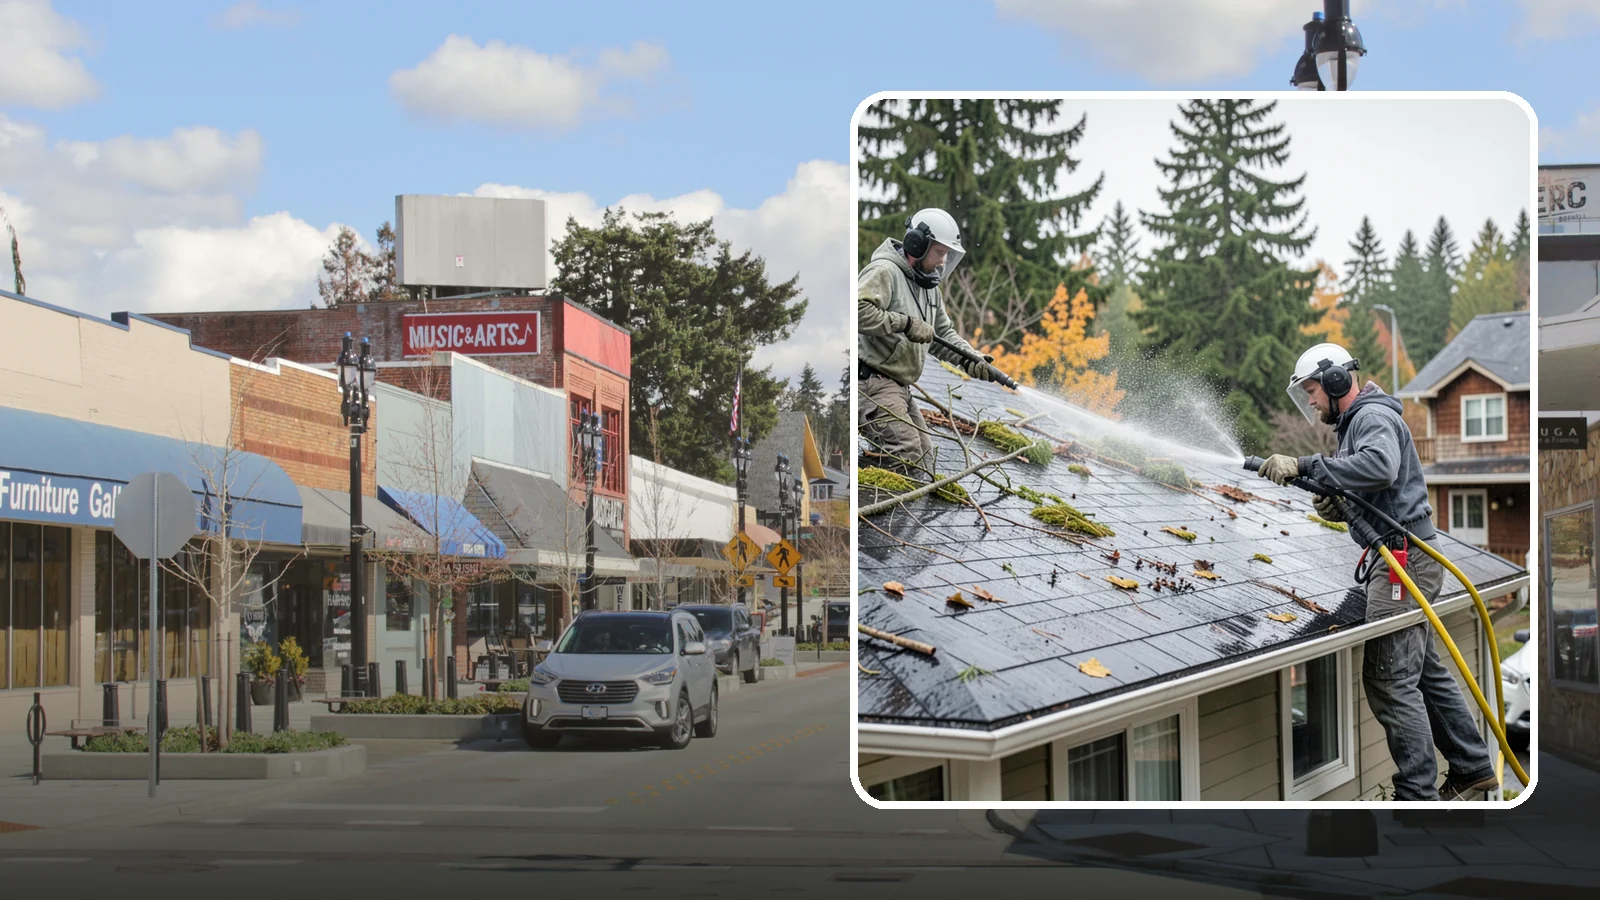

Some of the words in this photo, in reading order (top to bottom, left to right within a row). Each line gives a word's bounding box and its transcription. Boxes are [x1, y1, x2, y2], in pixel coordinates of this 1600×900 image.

[409, 322, 520, 349] MUSIC&ARTS
[1540, 427, 1577, 436] UGA
[0, 472, 79, 514] Furniture
